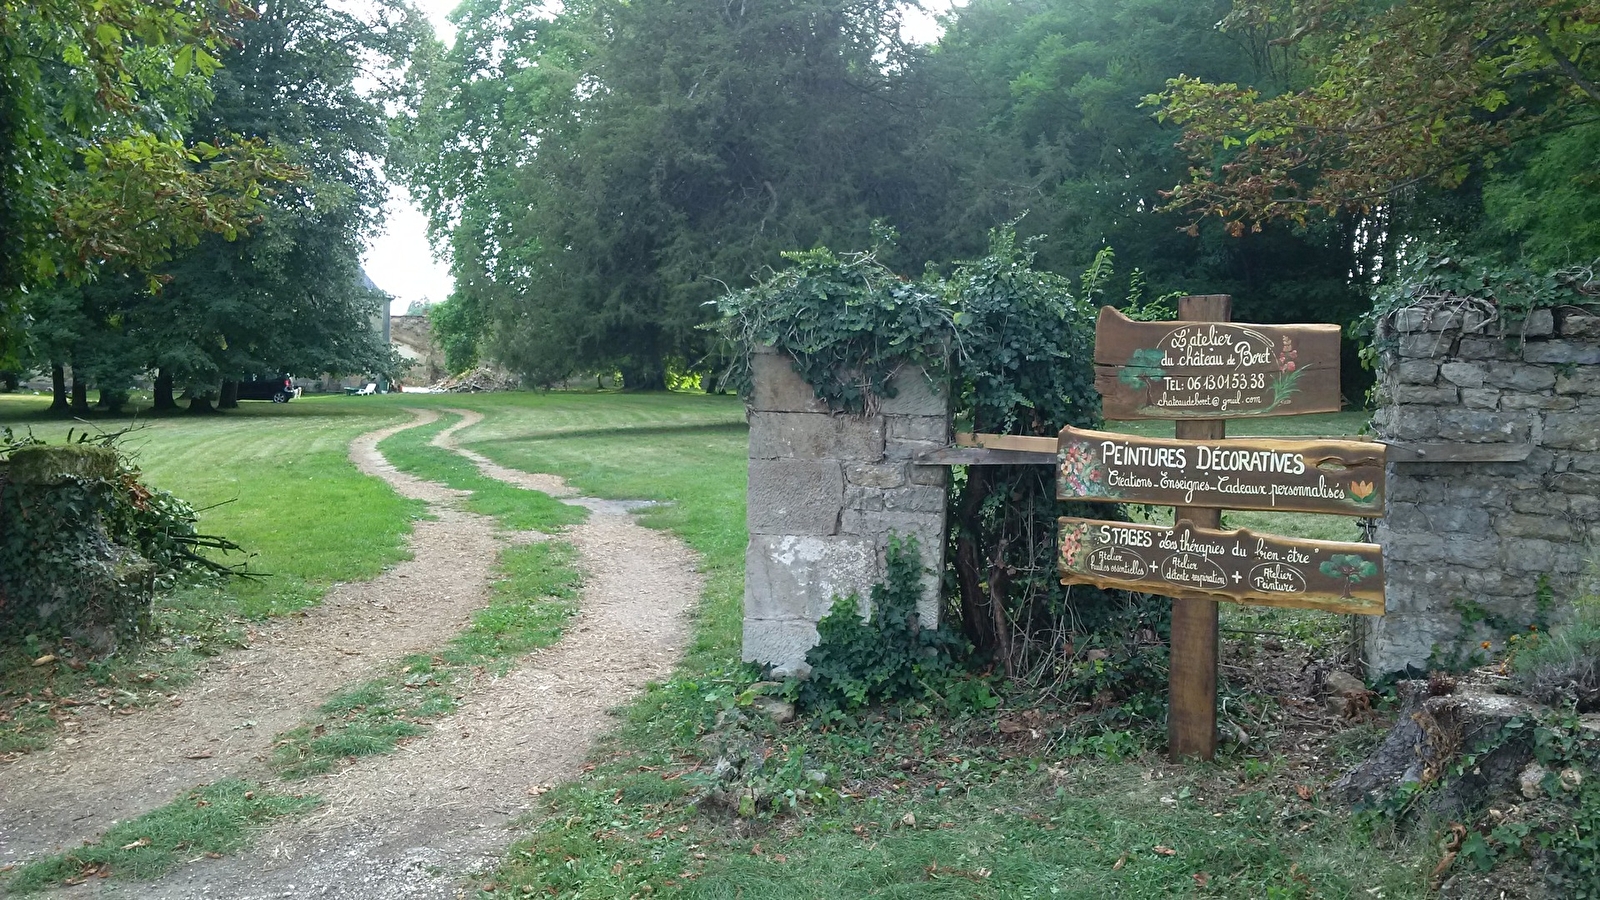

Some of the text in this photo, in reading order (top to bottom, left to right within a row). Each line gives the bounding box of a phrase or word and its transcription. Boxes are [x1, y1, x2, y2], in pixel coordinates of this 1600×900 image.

[1171, 324, 1233, 348] L'atelier
[1161, 341, 1271, 371] du château de Boret
[1163, 373, 1265, 390] TEL: 06.13.01.53.38
[1108, 468, 1153, 488] Créations
[1160, 471, 1210, 503] Enseignes
[1218, 475, 1267, 495] Cadeaux
[1268, 475, 1345, 506] personnalisés
[1100, 525, 1152, 547] STAGES
[1180, 529, 1225, 562] thérapies
[1232, 541, 1247, 557] du
[1099, 547, 1123, 561] Atelier
[1172, 554, 1198, 570] Atelier
[1263, 564, 1294, 581] Atelier
[1254, 577, 1297, 592] Peinture
